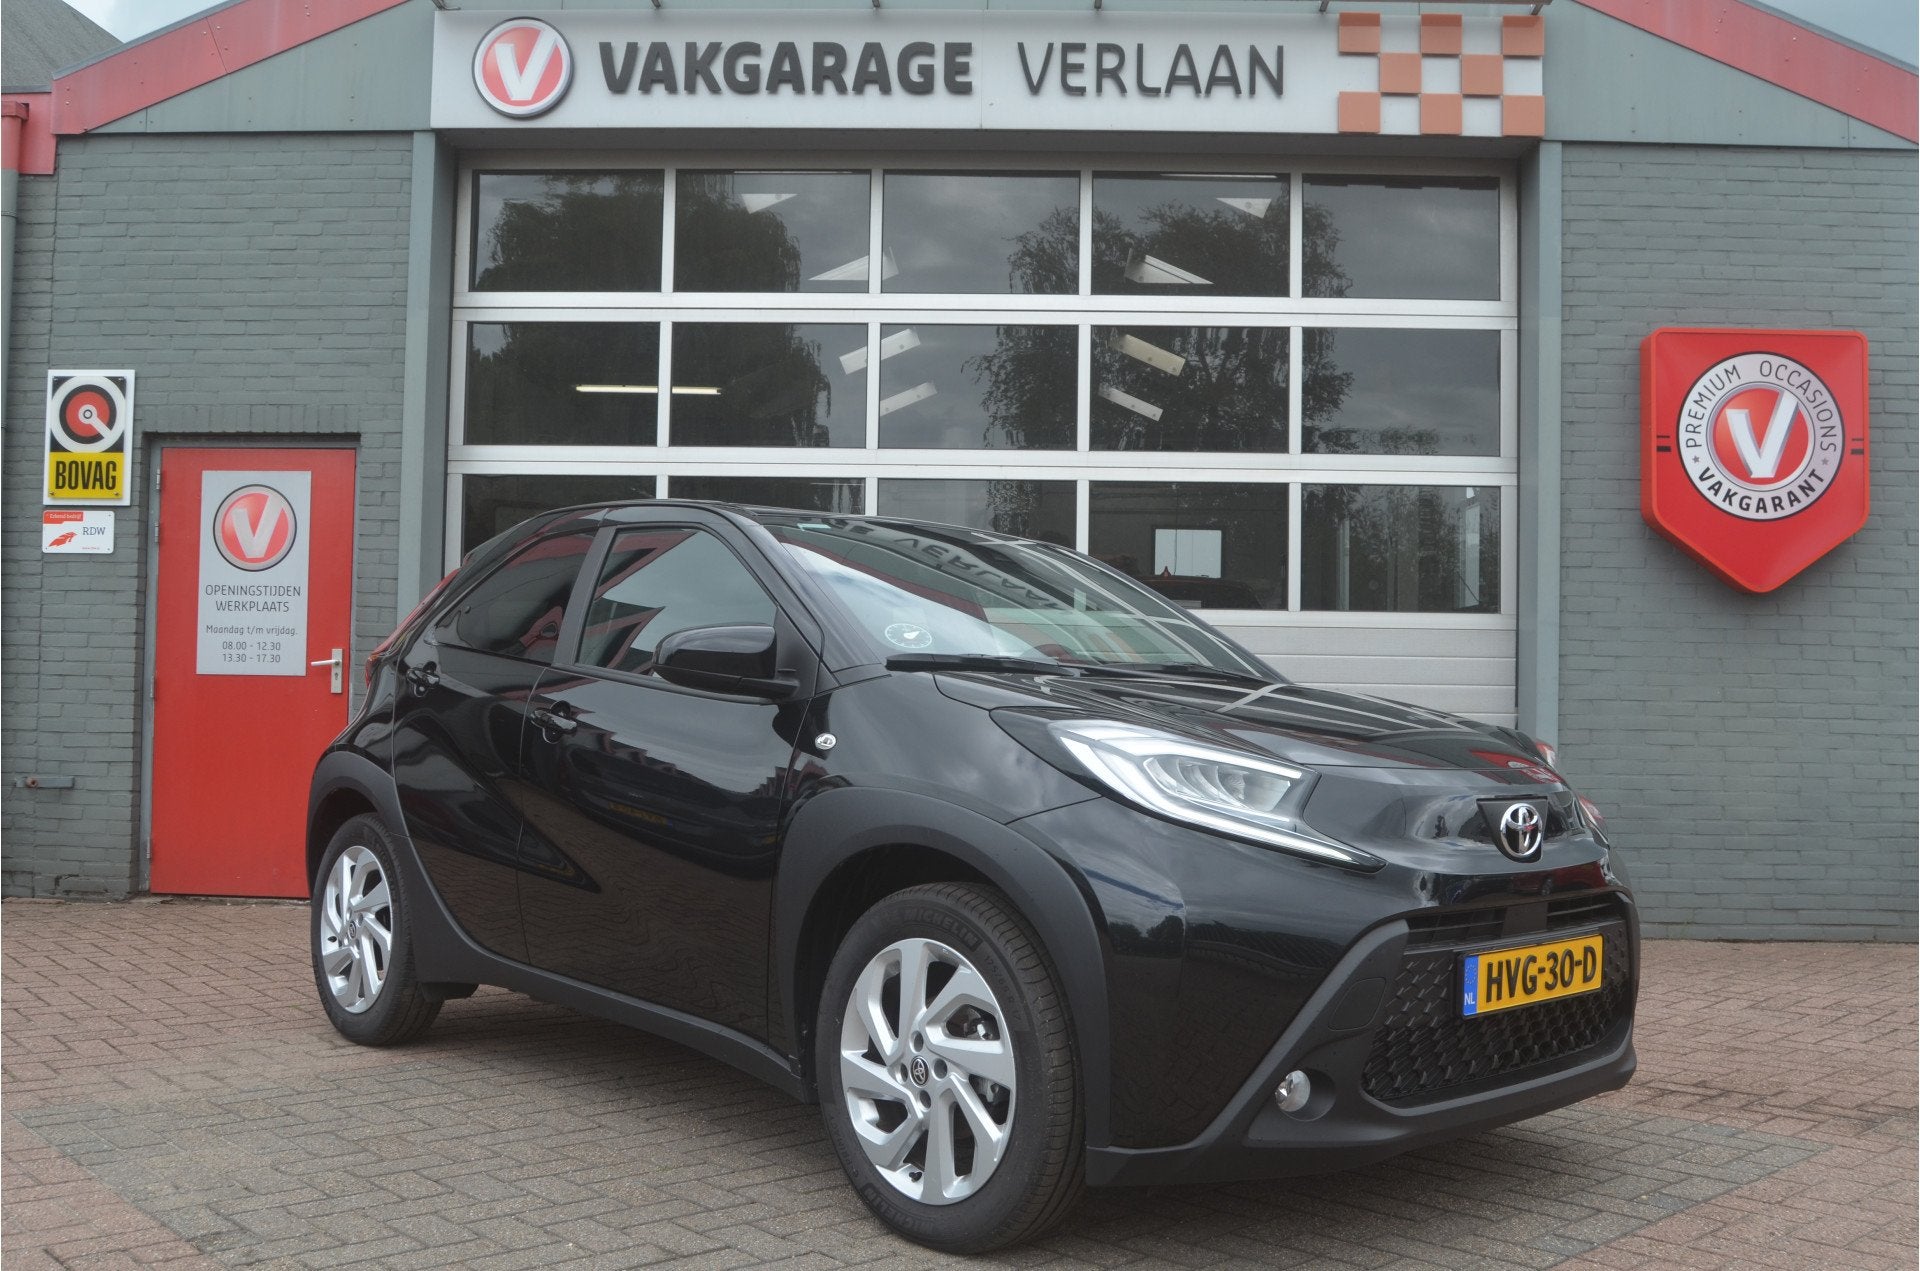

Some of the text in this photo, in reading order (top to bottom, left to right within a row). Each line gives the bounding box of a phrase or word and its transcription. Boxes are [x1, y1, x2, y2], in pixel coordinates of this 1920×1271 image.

[598, 41, 1284, 96] VAKGARAGE VERLAAN
[1685, 360, 1837, 452] PREMIUM OCCASIONS
[1725, 390, 1800, 479] V
[54, 460, 117, 491] BOVAG
[1698, 466, 1825, 514] VAKGARANT
[82, 526, 106, 536] RDW
[205, 584, 301, 597] OPENINGSTIJDEN
[215, 600, 290, 613] WERKPLAATS
[206, 624, 244, 636] Maandag
[247, 625, 264, 635] t/m
[222, 641, 247, 651] 08.00
[256, 641, 281, 651] 12.30
[222, 653, 247, 663] 13.30
[256, 653, 281, 663] 17.30
[1463, 944, 1597, 1006] NL HVG-30-D
